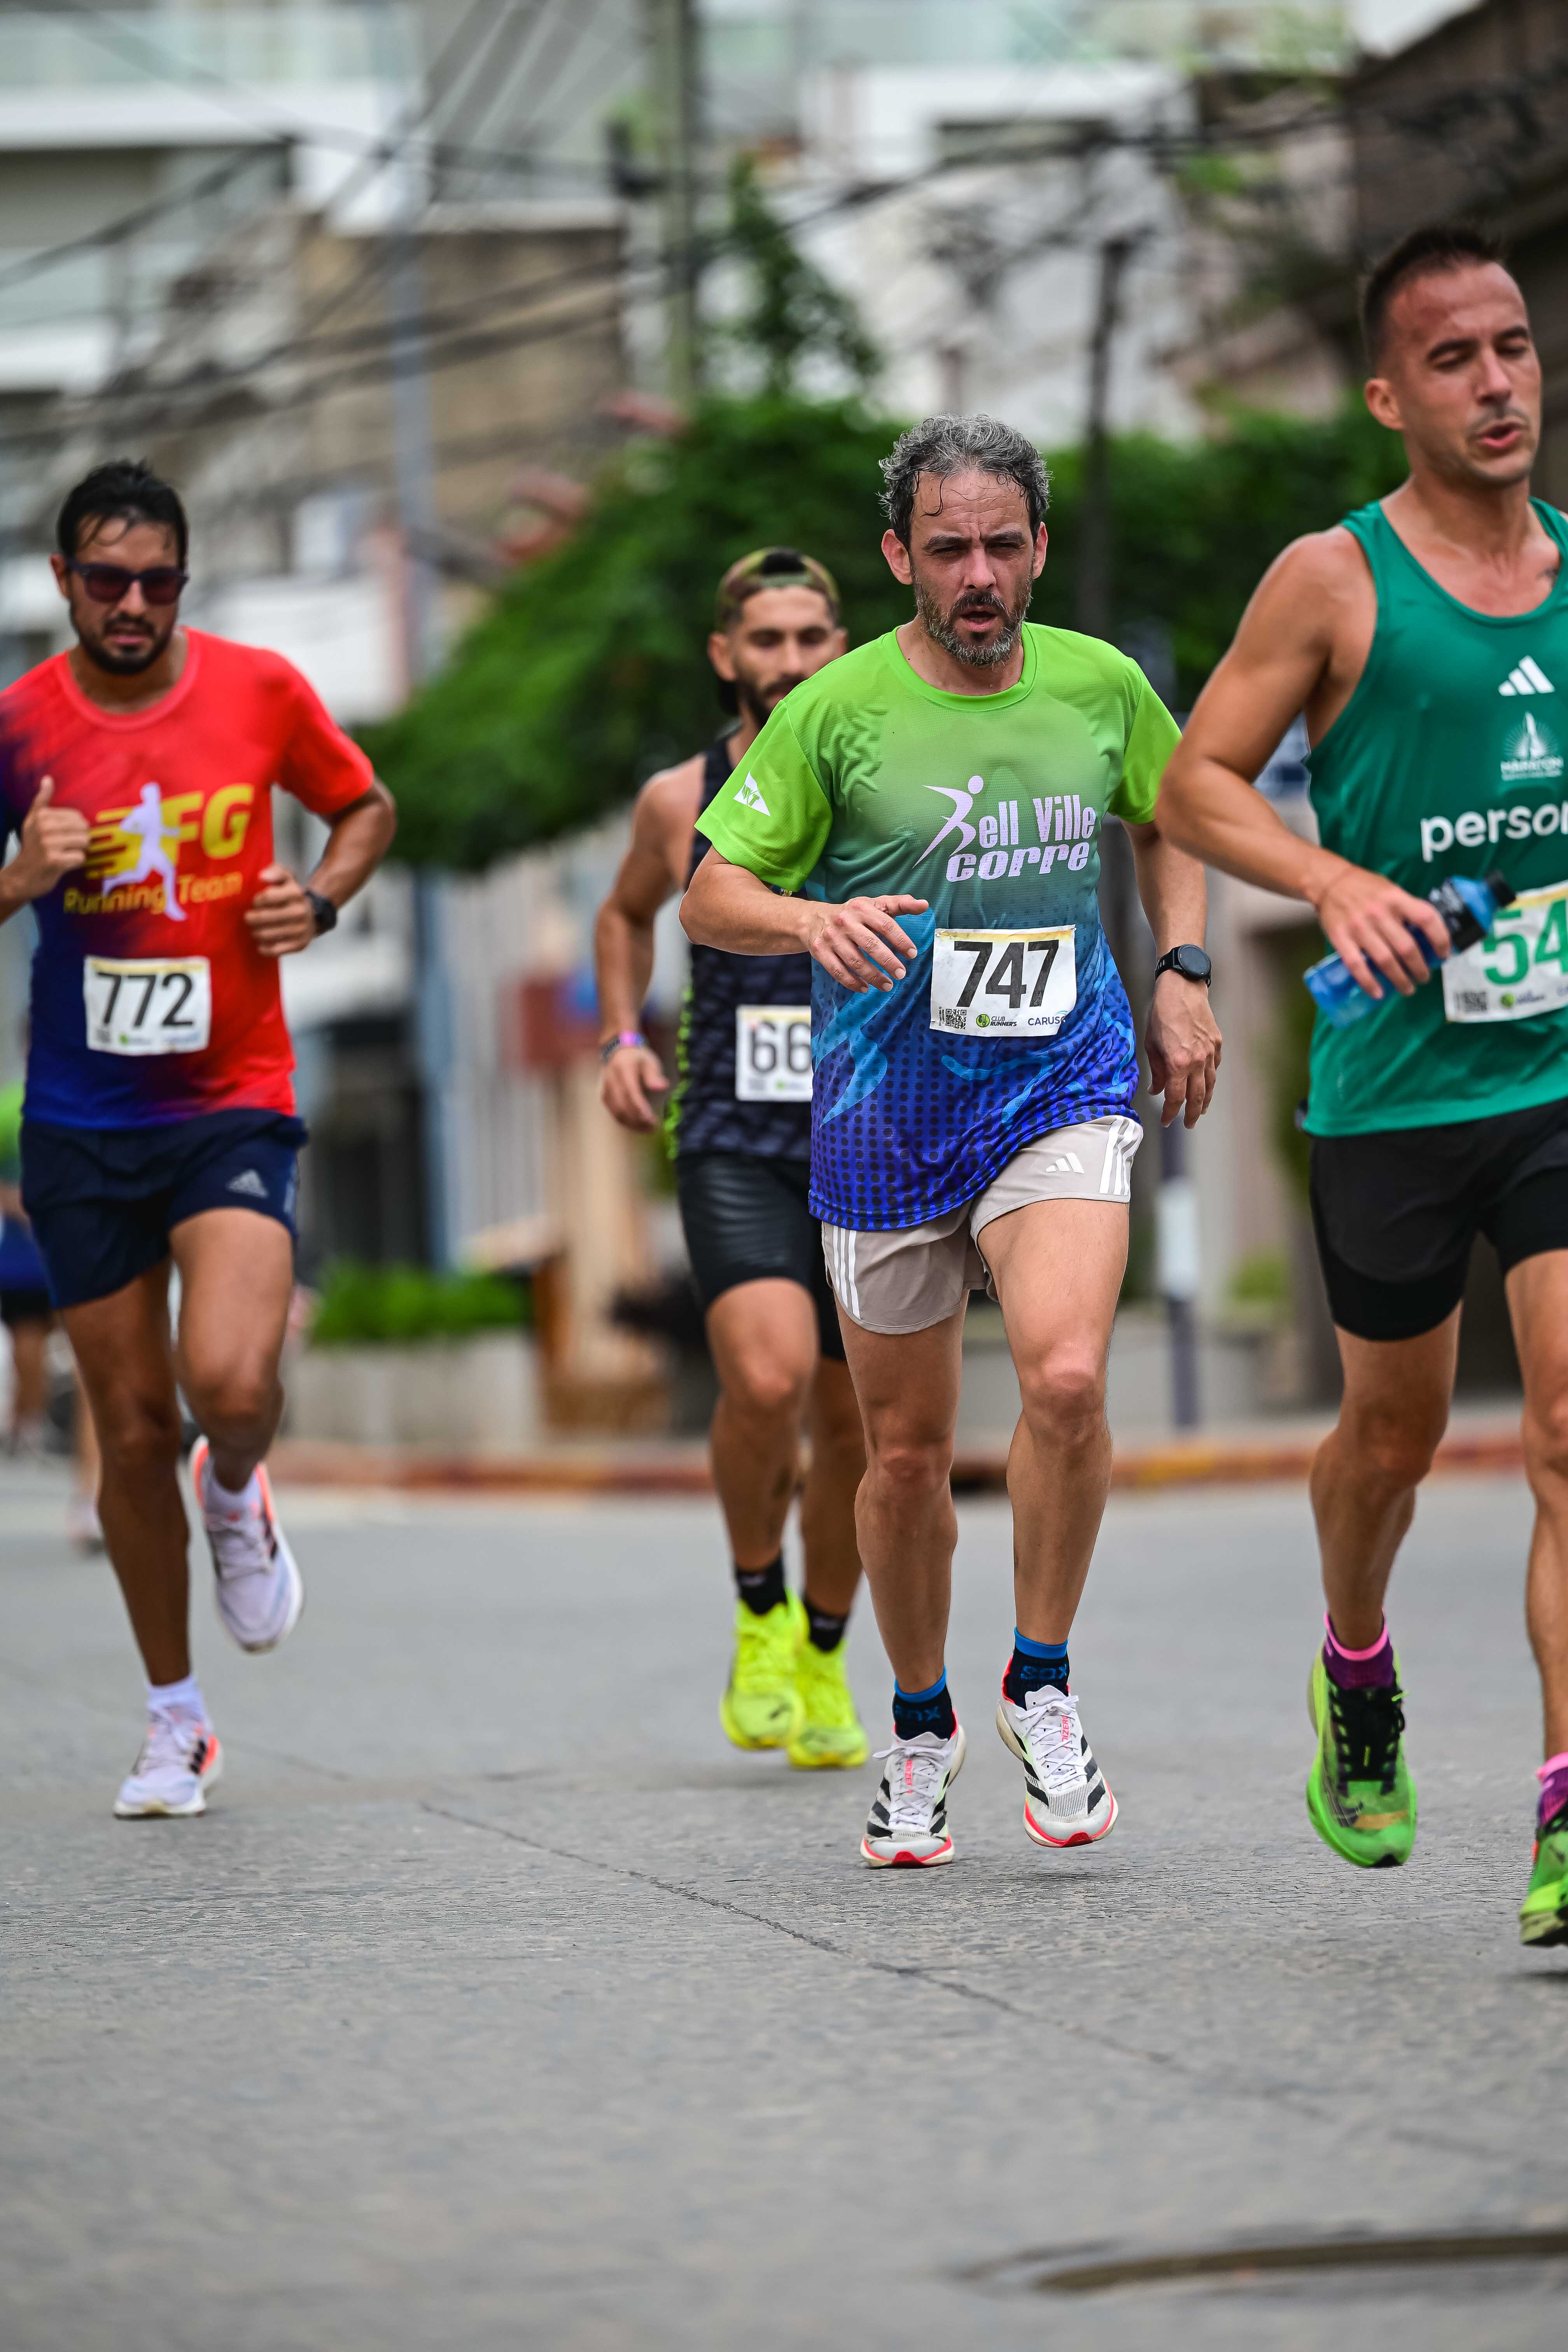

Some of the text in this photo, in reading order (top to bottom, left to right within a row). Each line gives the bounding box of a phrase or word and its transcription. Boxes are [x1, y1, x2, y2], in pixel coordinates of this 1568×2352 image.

[1033, 794, 1096, 843] Ville
[1420, 800, 1568, 863] perso
[63, 872, 243, 915] Running Team
[1482, 899, 1568, 986] 54
[96, 972, 194, 1028] 772
[954, 940, 1059, 1008] 747
